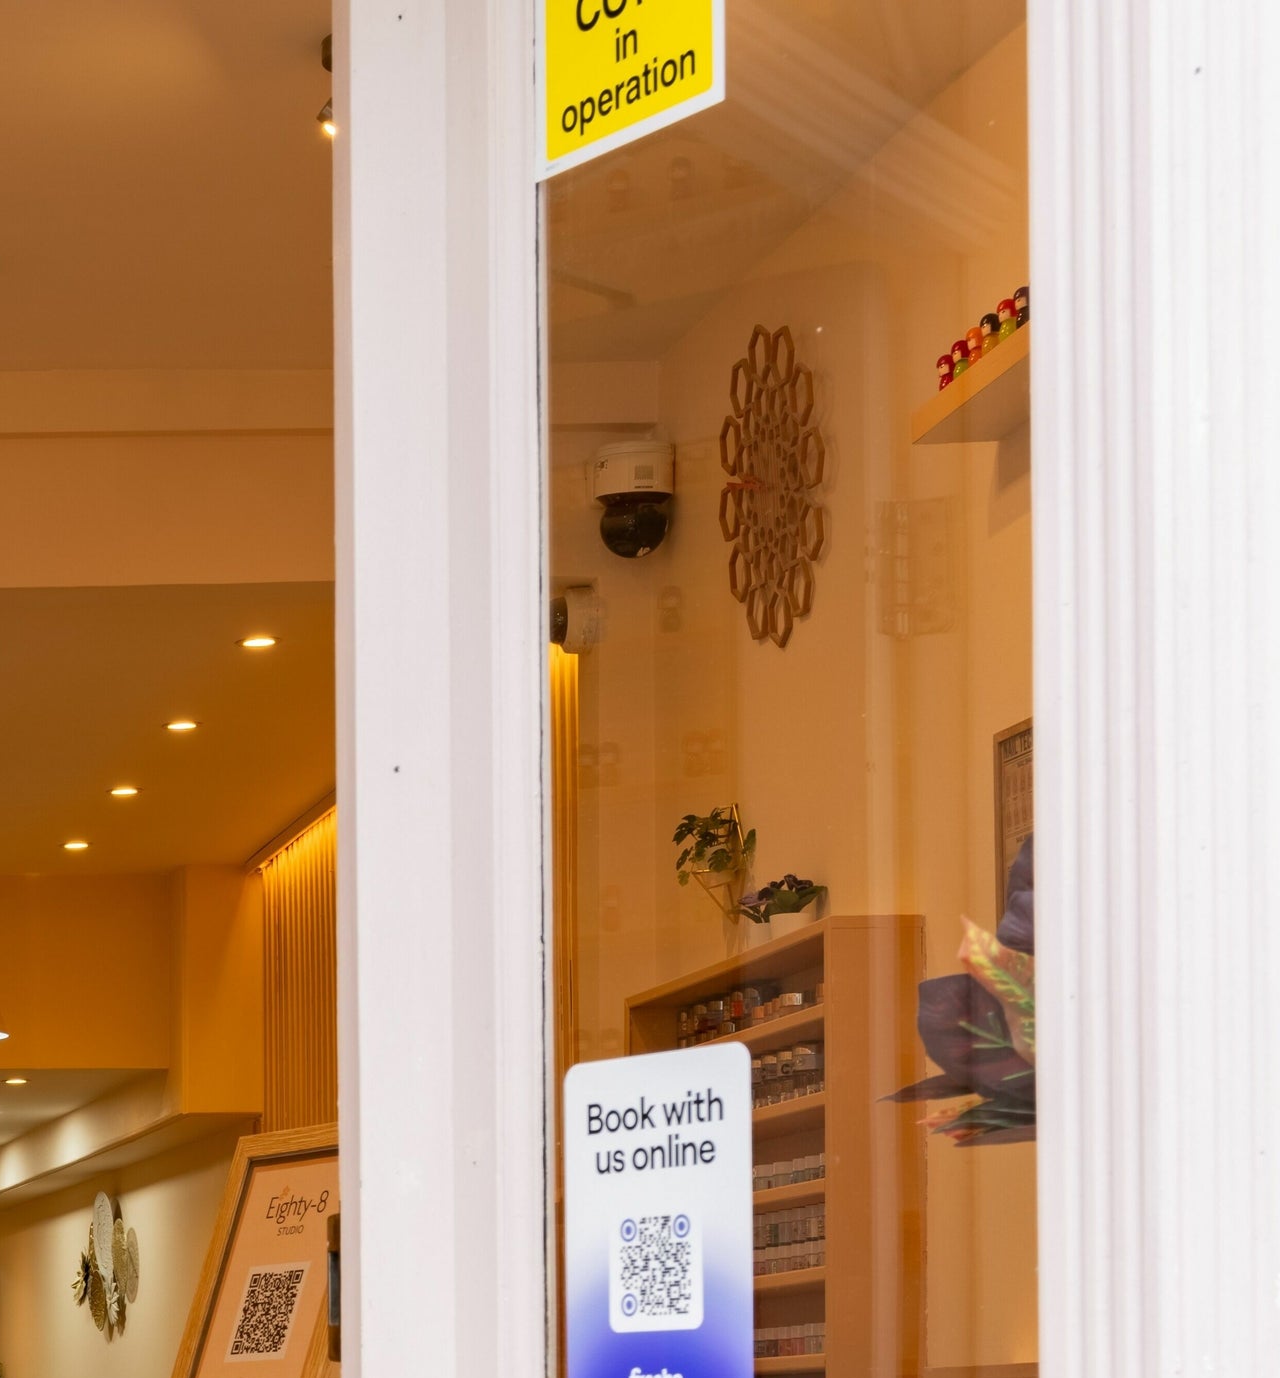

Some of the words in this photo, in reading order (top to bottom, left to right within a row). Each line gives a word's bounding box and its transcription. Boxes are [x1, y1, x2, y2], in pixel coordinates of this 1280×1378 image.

[615, 27, 638, 62] in
[561, 49, 696, 136] operation
[587, 1096, 656, 1136] Book
[663, 1088, 725, 1126] with
[596, 1147, 625, 1175] us
[632, 1133, 716, 1171] online
[266, 1190, 330, 1225] Eighty-8
[277, 1225, 305, 1237] STUDIO
